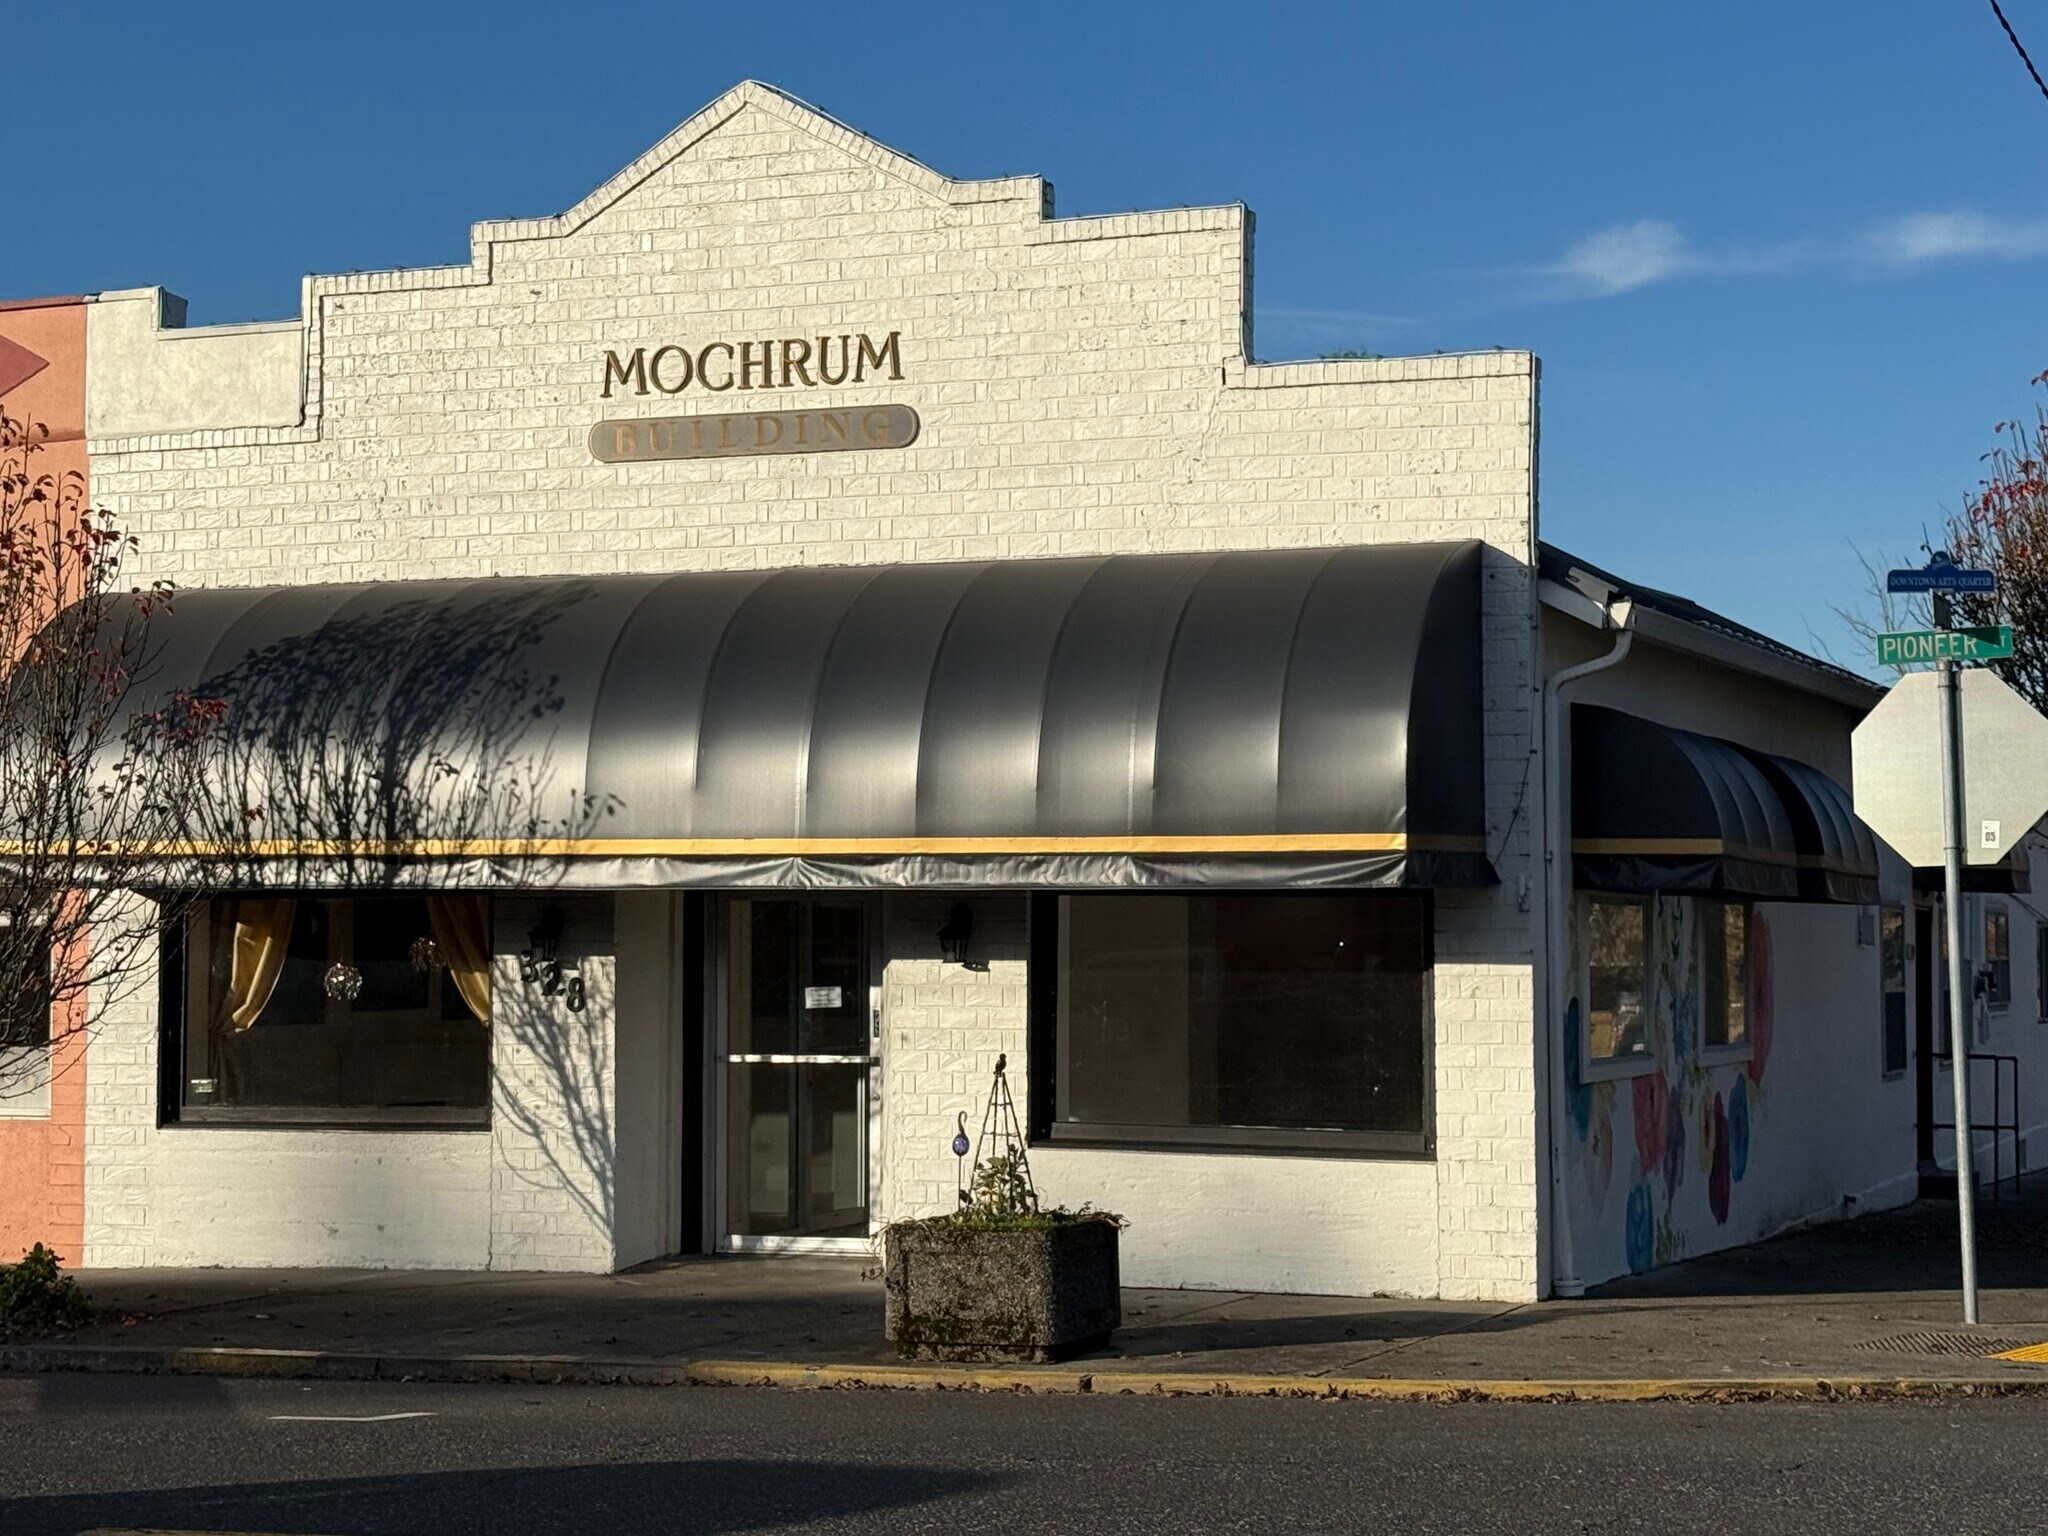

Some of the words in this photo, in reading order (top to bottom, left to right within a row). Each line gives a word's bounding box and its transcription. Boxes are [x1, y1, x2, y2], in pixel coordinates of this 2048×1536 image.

[600, 331, 905, 398] MOCHRUM
[614, 410, 891, 454] BUILDING
[1890, 576, 1936, 587] DOWNTOWN
[1937, 576, 1957, 587] ARTS
[1958, 576, 1992, 588] QUARTER
[1882, 632, 1978, 660] PIONEER
[520, 950, 587, 1013] 328
